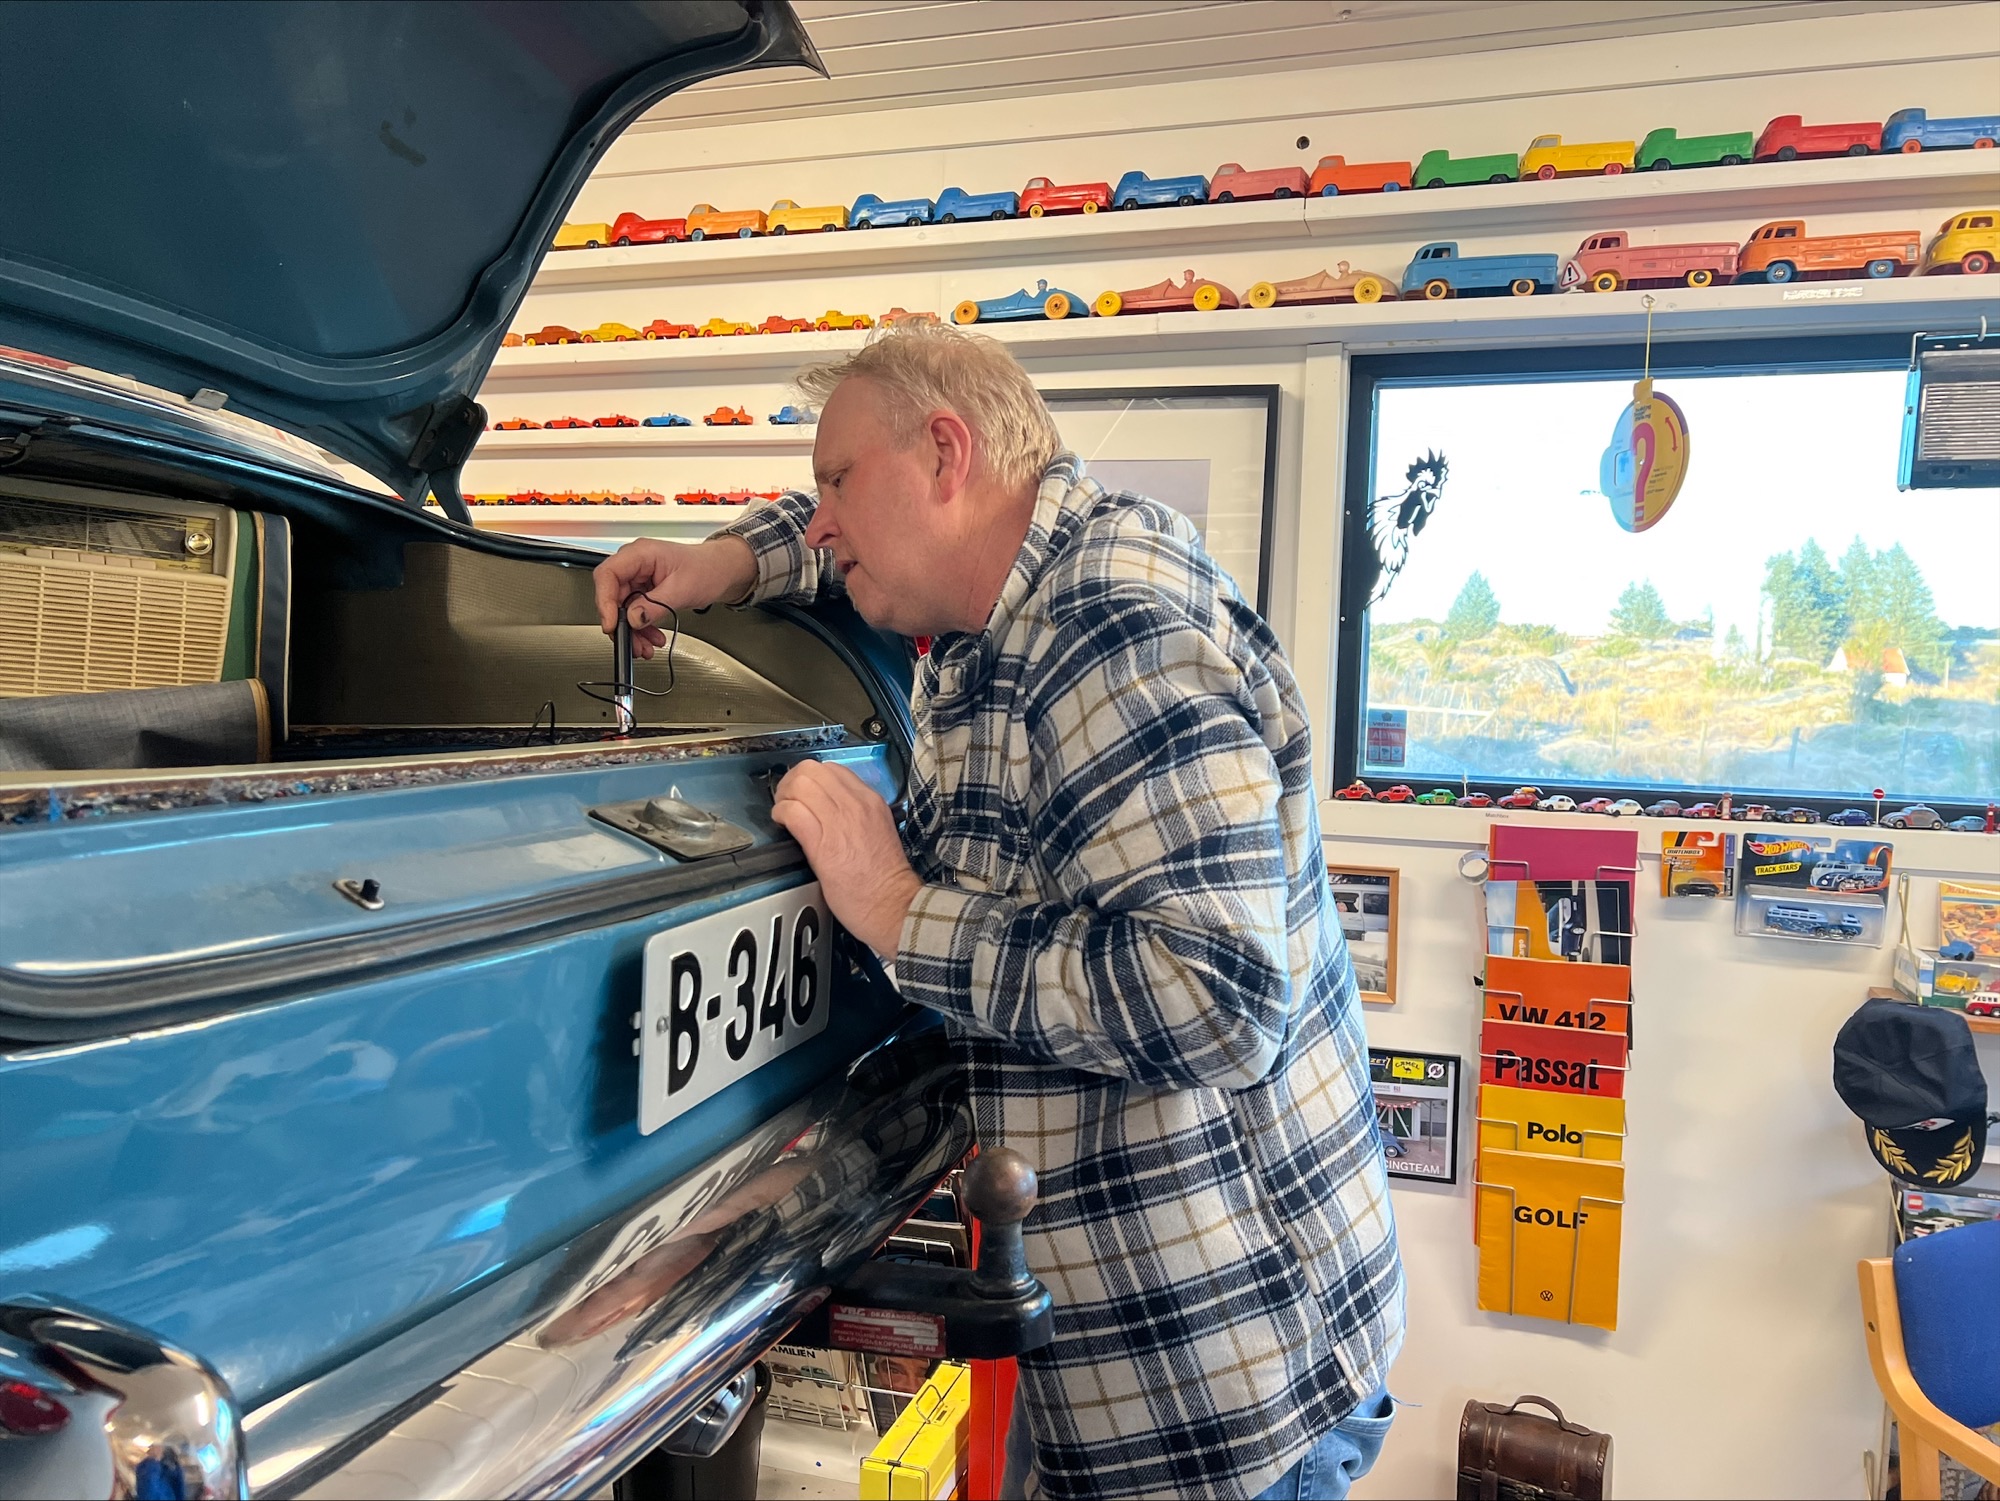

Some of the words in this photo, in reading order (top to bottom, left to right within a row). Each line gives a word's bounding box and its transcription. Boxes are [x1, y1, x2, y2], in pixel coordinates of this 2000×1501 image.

[1764, 842, 1782, 855] HOT
[1782, 840, 1812, 853] WHEELS
[1756, 865, 1776, 874] TRACK
[1778, 863, 1799, 872] STARS
[667, 904, 820, 1097] B-346
[1499, 1003, 1549, 1025] VW
[1554, 1010, 1606, 1031] 412
[1395, 1061, 1420, 1070] CAMEL
[1495, 1049, 1599, 1090] Passat
[1527, 1121, 1583, 1145] Polo
[1514, 1205, 1589, 1230] GOLF
